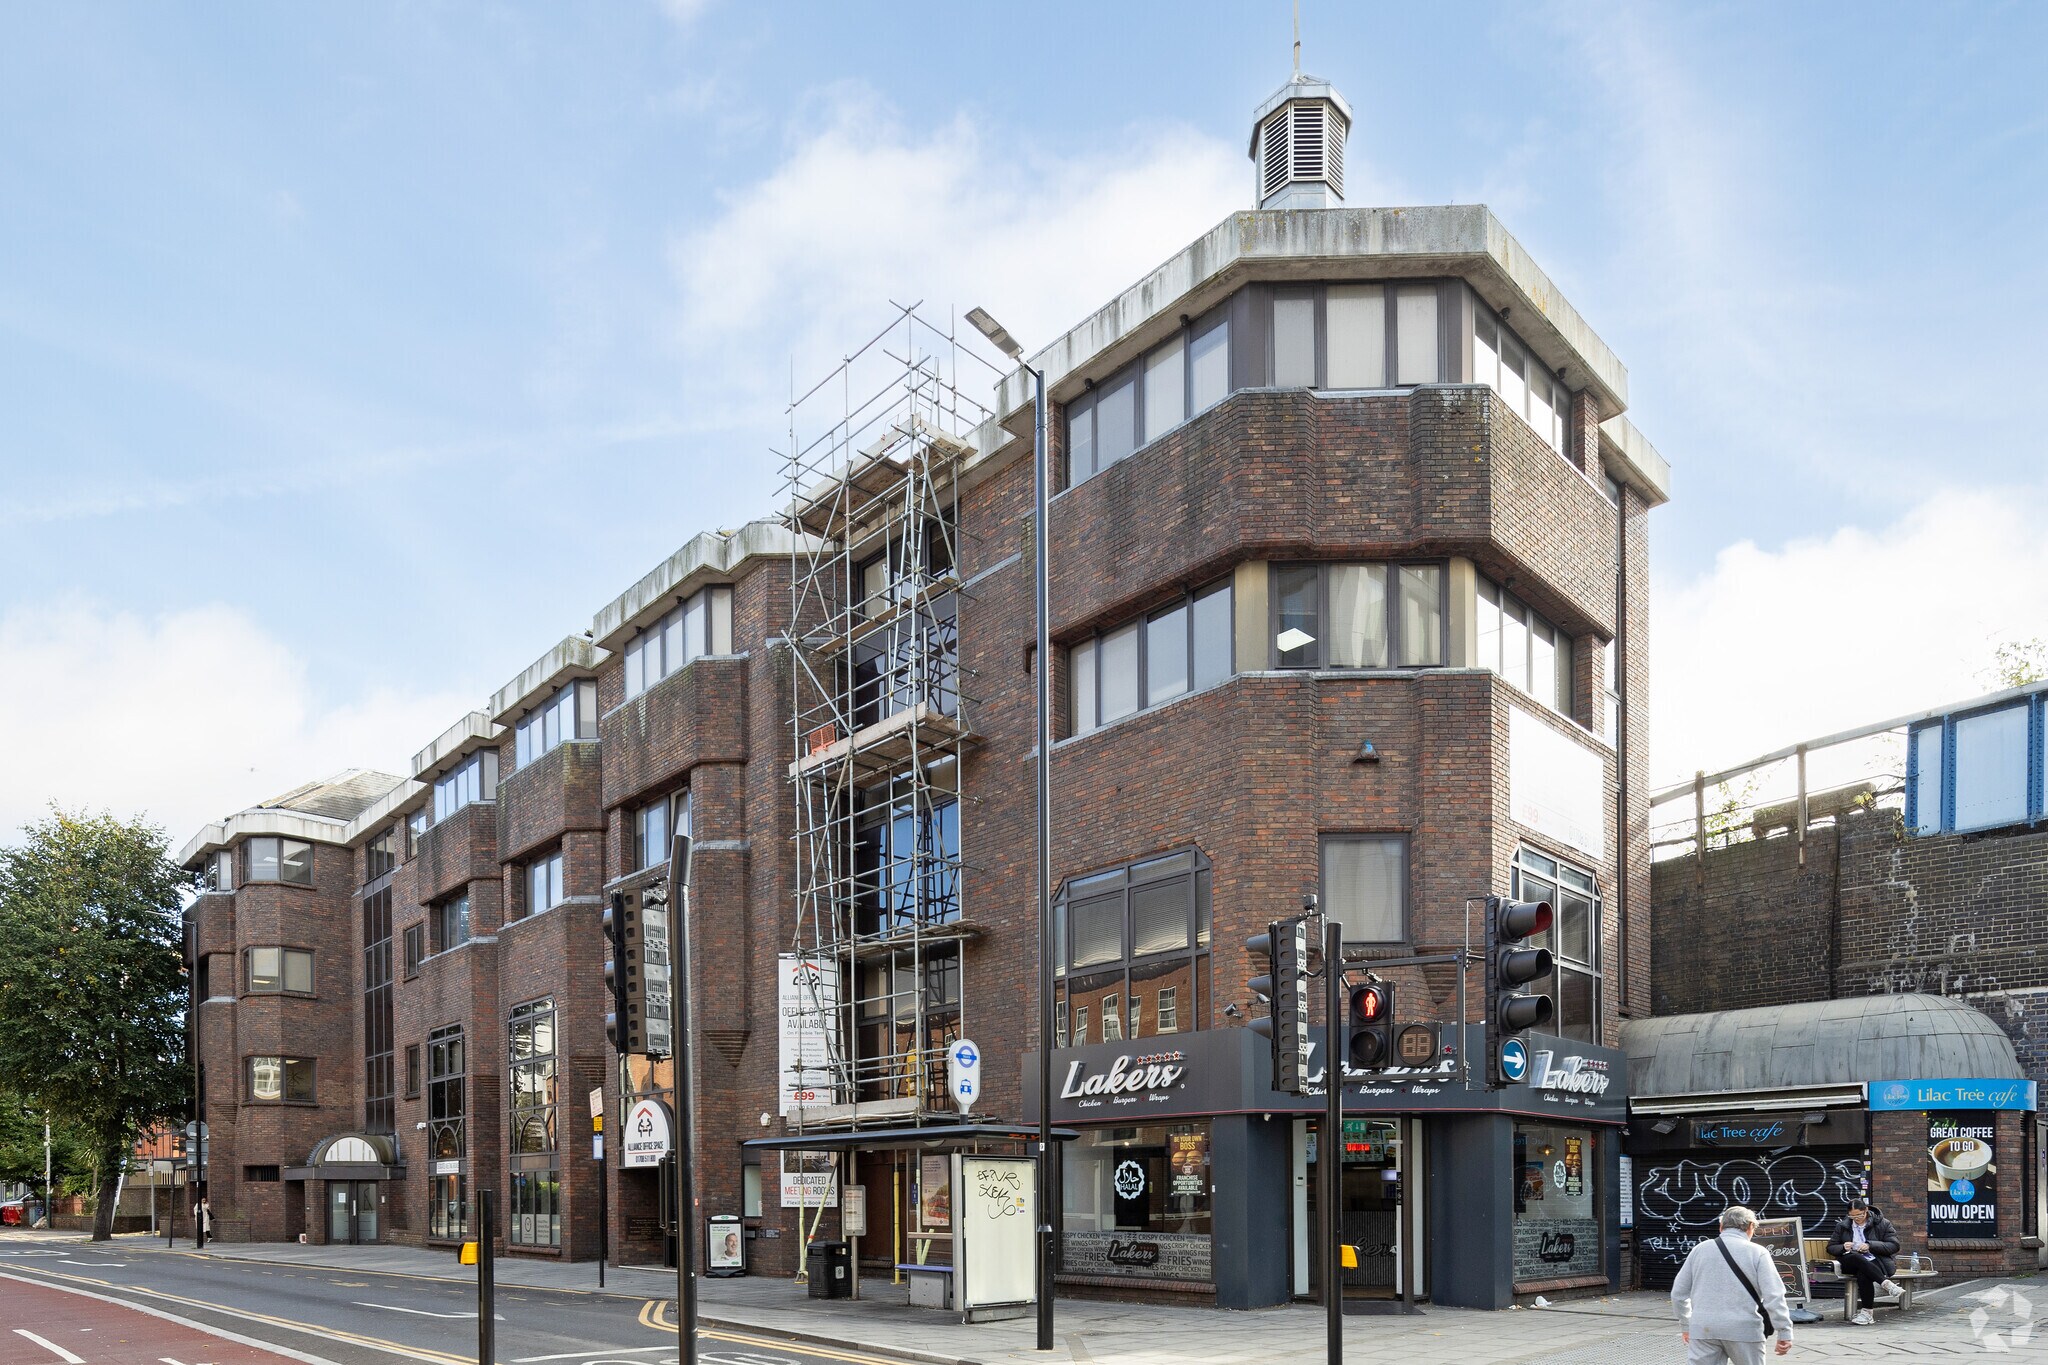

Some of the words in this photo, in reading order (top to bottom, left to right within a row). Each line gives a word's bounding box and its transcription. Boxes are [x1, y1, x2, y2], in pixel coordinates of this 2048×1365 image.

[782, 1007, 806, 1017] OFFIE
[787, 1019, 826, 1028] AVAILABL
[1060, 1055, 1183, 1098] Lakers
[1535, 1050, 1610, 1094] Lakers
[794, 1092, 815, 1100] £99
[1360, 1086, 1395, 1096] Burgers
[1412, 1086, 1441, 1096] Wraps
[1918, 1088, 1951, 1102] Lilac
[1955, 1088, 1984, 1100] Tree
[1988, 1084, 2018, 1108] cafe
[1079, 1099, 1102, 1108] Chicken
[1113, 1096, 1137, 1105] Burgers
[1149, 1094, 1170, 1103] Wraps
[1720, 1126, 1746, 1137] Tree
[1750, 1121, 1785, 1142] cafe
[1930, 1127, 1958, 1138] GREAT
[1960, 1127, 1993, 1138] COFFEE
[1180, 1142, 1196, 1150] BOSS
[1949, 1141, 1960, 1151] TO
[1962, 1141, 1974, 1151] GO
[793, 1176, 826, 1185] DEDICATED
[784, 1187, 811, 1195] MEETNG
[1931, 1205, 1959, 1219] NOW
[1962, 1205, 1994, 1219] OPEN
[1754, 1224, 1790, 1236] OPEN
[1541, 1236, 1572, 1254] Lakers
[1110, 1243, 1156, 1259] Lakers
[1085, 1252, 1105, 1261] FRIES
[1167, 1256, 1191, 1265] FRIES
